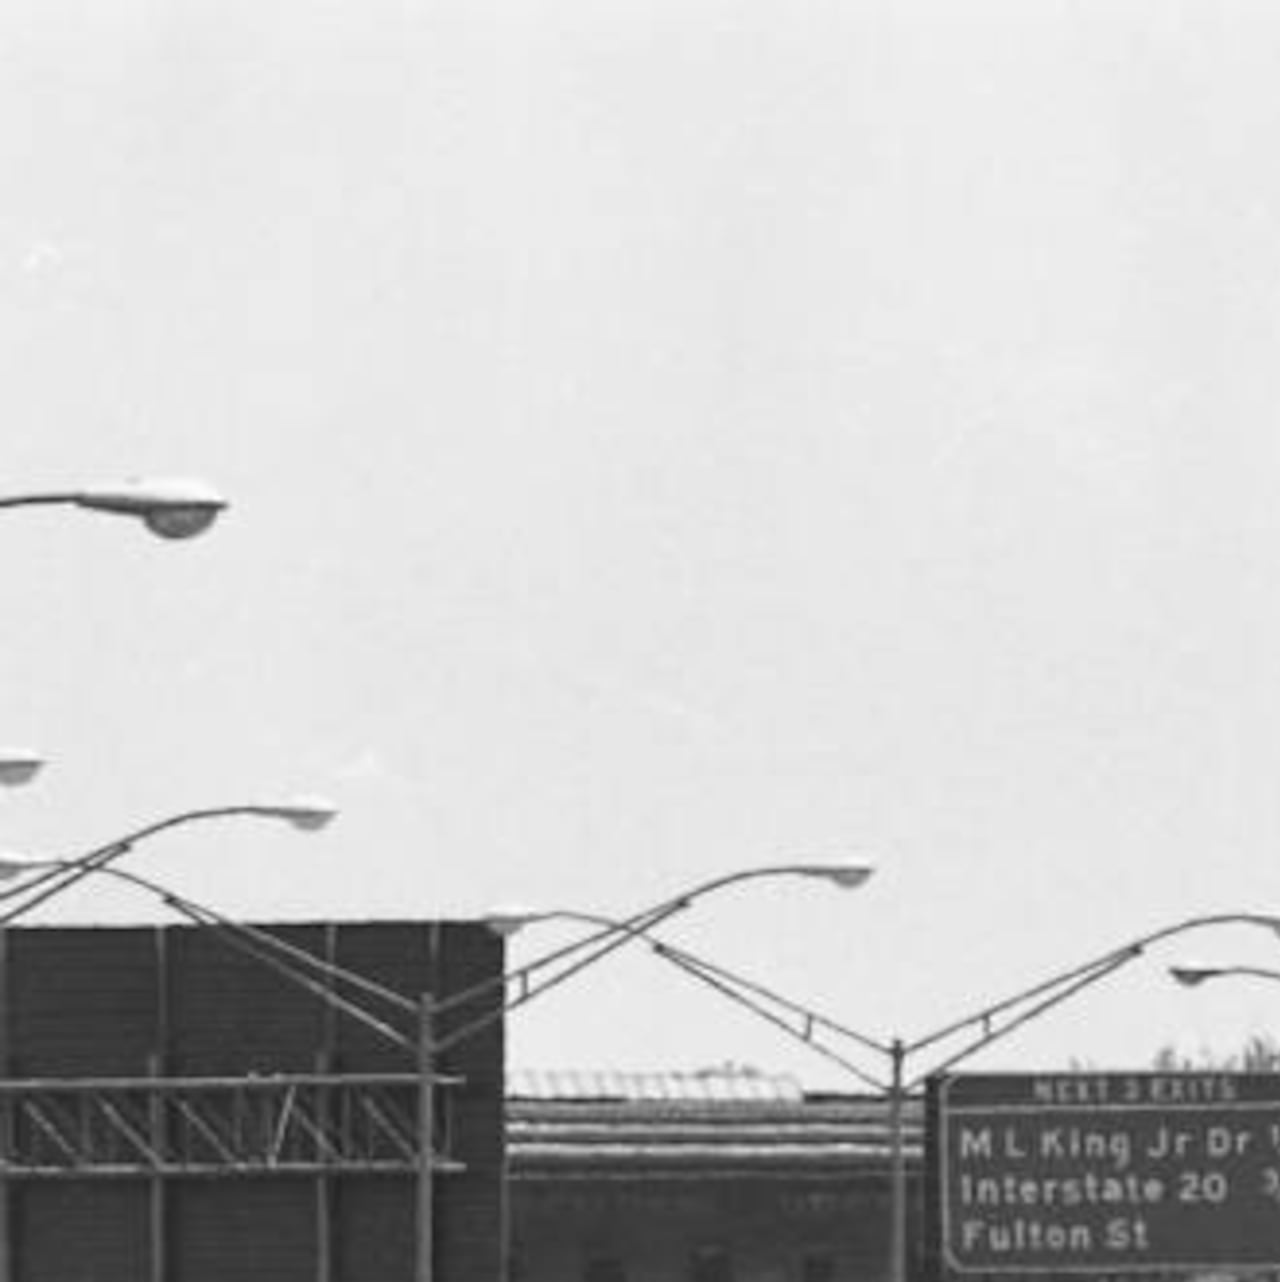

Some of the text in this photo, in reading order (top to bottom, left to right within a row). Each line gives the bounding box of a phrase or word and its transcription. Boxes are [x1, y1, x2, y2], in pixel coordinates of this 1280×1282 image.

[960, 1128, 993, 1158] M
[1004, 1129, 1027, 1158] L
[1040, 1127, 1132, 1168] King
[1147, 1126, 1193, 1158] Jr
[1207, 1126, 1252, 1157] Dr
[960, 1173, 1166, 1203] Interstate
[1179, 1172, 1229, 1202] 20
[960, 1218, 1093, 1251] Fulton
[1104, 1216, 1149, 1250] St
